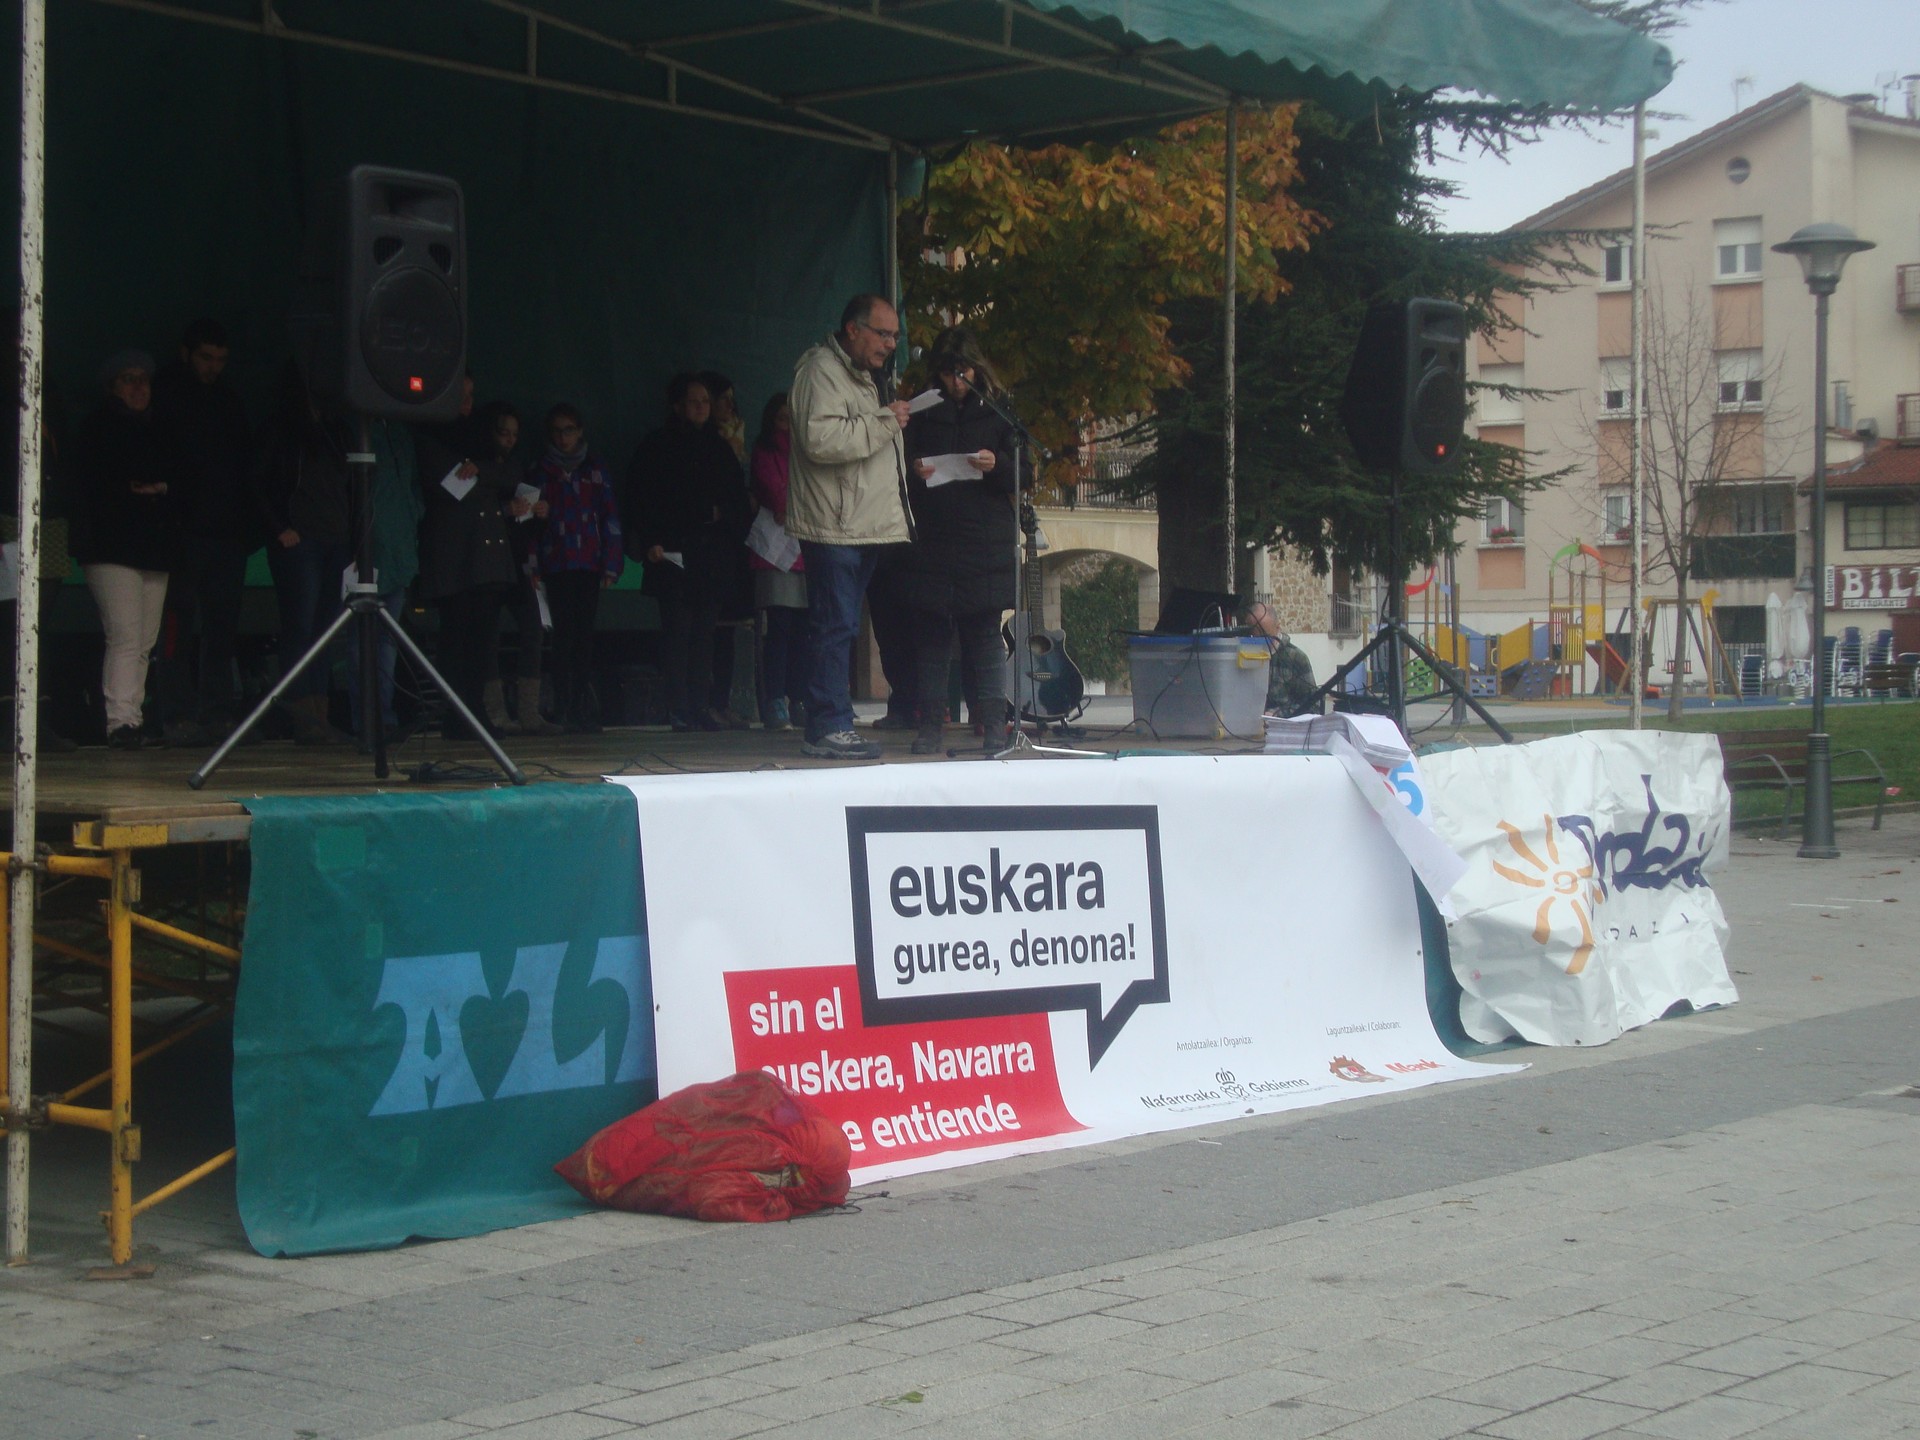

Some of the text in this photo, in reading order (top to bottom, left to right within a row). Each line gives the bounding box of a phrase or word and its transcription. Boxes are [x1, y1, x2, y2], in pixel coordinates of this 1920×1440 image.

[889, 847, 1105, 918] euskara
[893, 922, 1136, 985] gurea, denona!
[749, 986, 845, 1036] sin el
[911, 1039, 1036, 1083] Navarra
[1223, 1036, 1253, 1049] Organiza:
[1140, 1089, 1221, 1109] Nafarroako
[1249, 1077, 1310, 1094] Gobierno
[871, 1094, 1022, 1148] entiende
